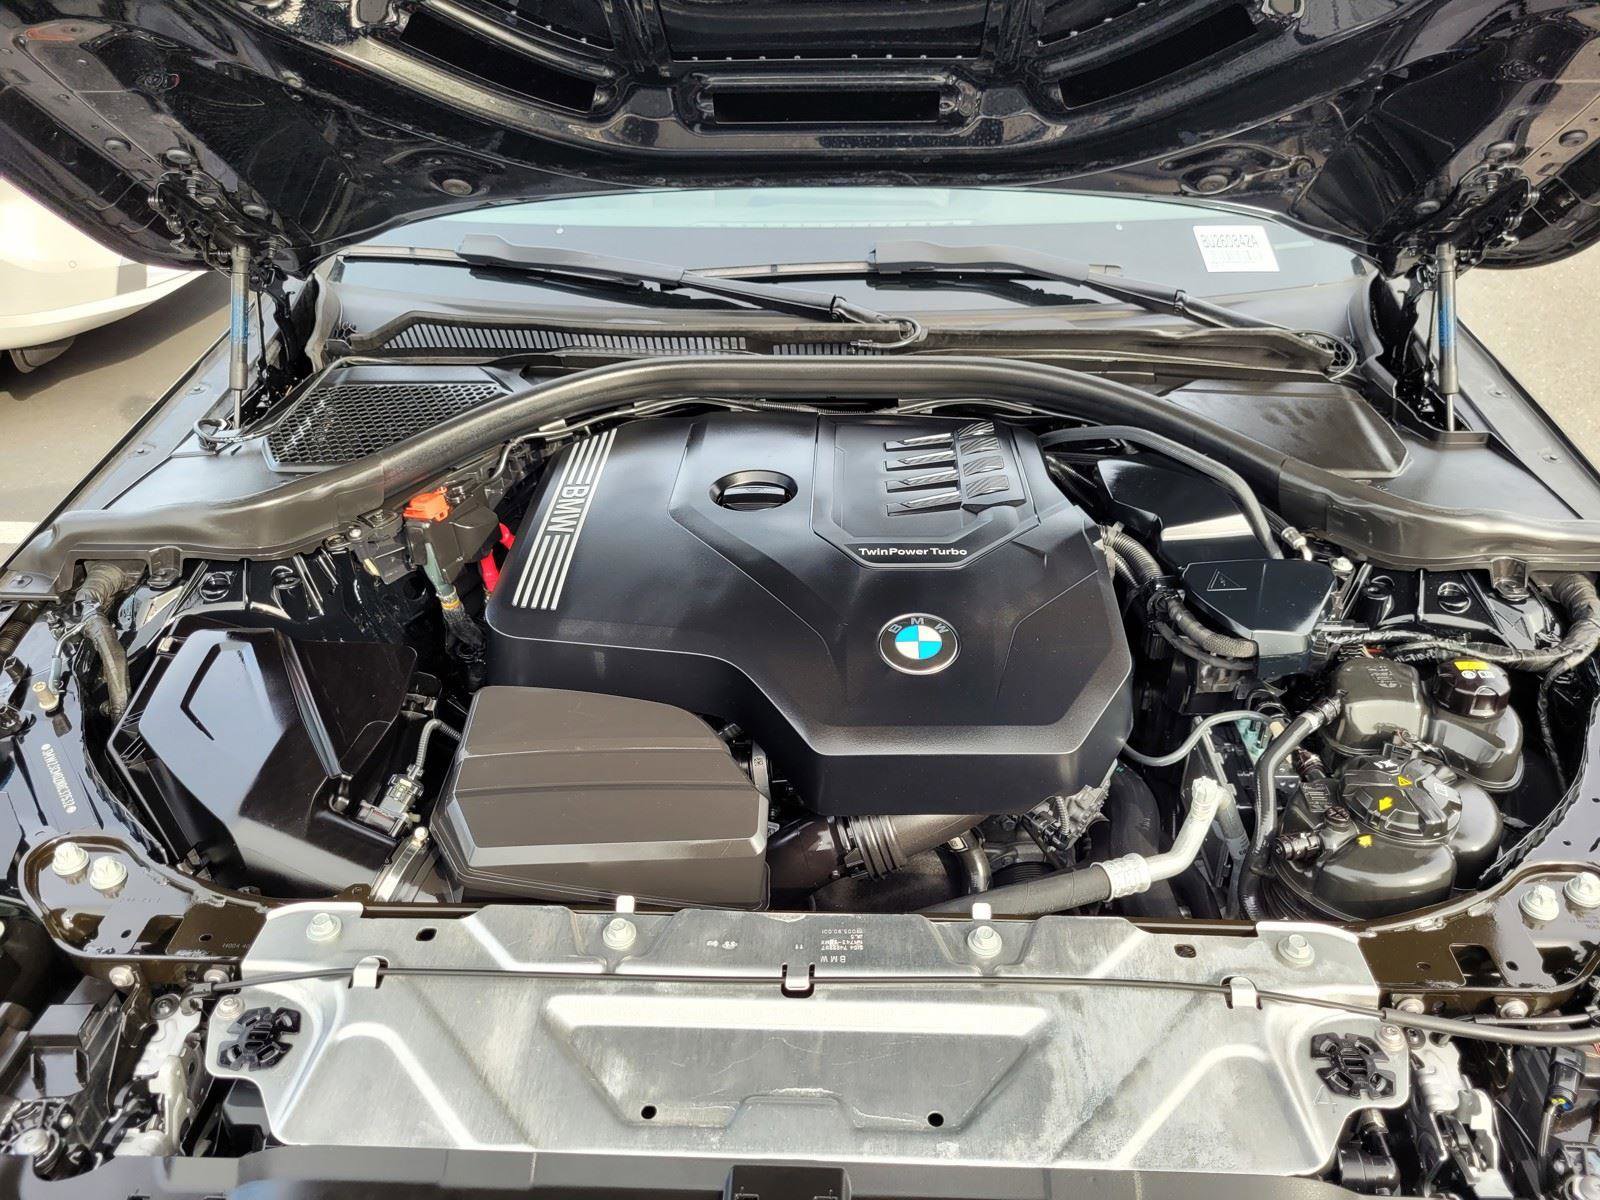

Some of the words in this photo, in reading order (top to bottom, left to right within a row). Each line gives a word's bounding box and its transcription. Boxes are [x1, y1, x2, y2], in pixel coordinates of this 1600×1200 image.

[547, 484, 590, 533] BMW
[858, 547, 929, 556] TwinPower
[930, 547, 968, 556] Turbo
[888, 617, 949, 634] BMW
[820, 955, 846, 963] BMW
